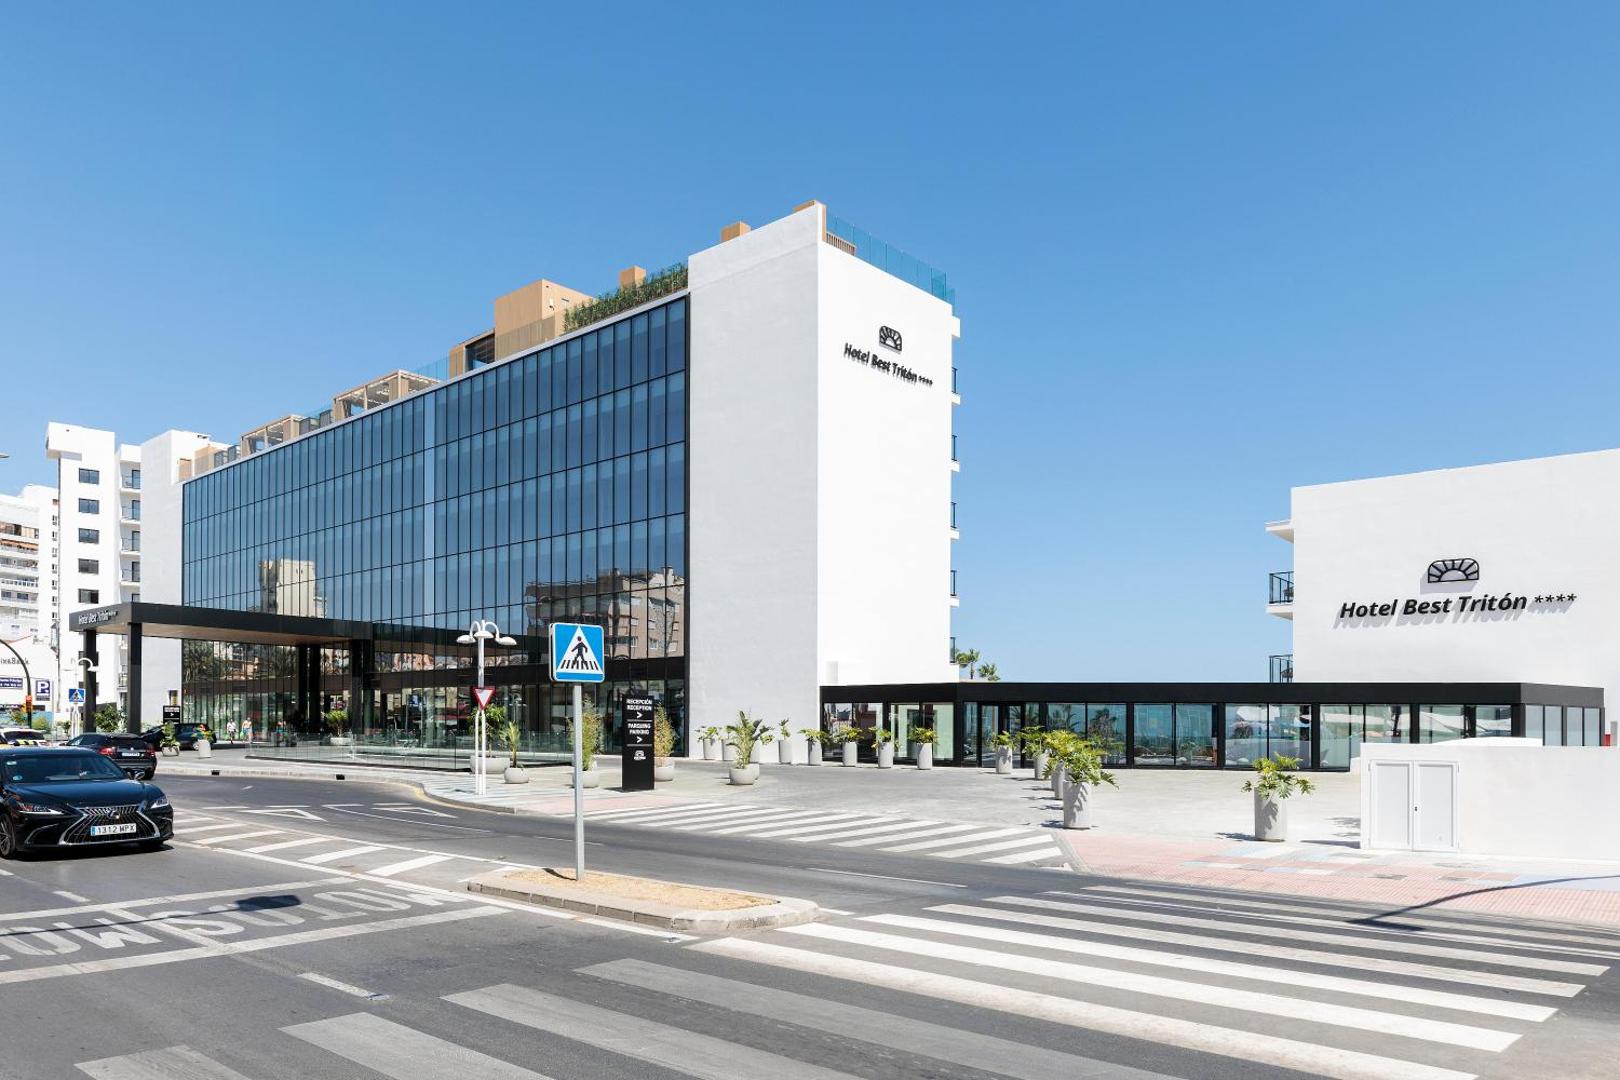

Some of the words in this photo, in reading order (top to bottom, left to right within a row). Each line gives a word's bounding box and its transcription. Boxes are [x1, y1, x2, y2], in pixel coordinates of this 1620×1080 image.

[844, 342, 870, 364] Hotel
[872, 354, 891, 373] Best
[892, 362, 918, 382] Tritón
[1340, 599, 1398, 619] Hotel
[1403, 596, 1451, 616] Best
[1458, 592, 1528, 613] Tritón
[37, 681, 49, 693] P
[98, 825, 118, 834] 1312
[147, 884, 444, 936] MOTOS
